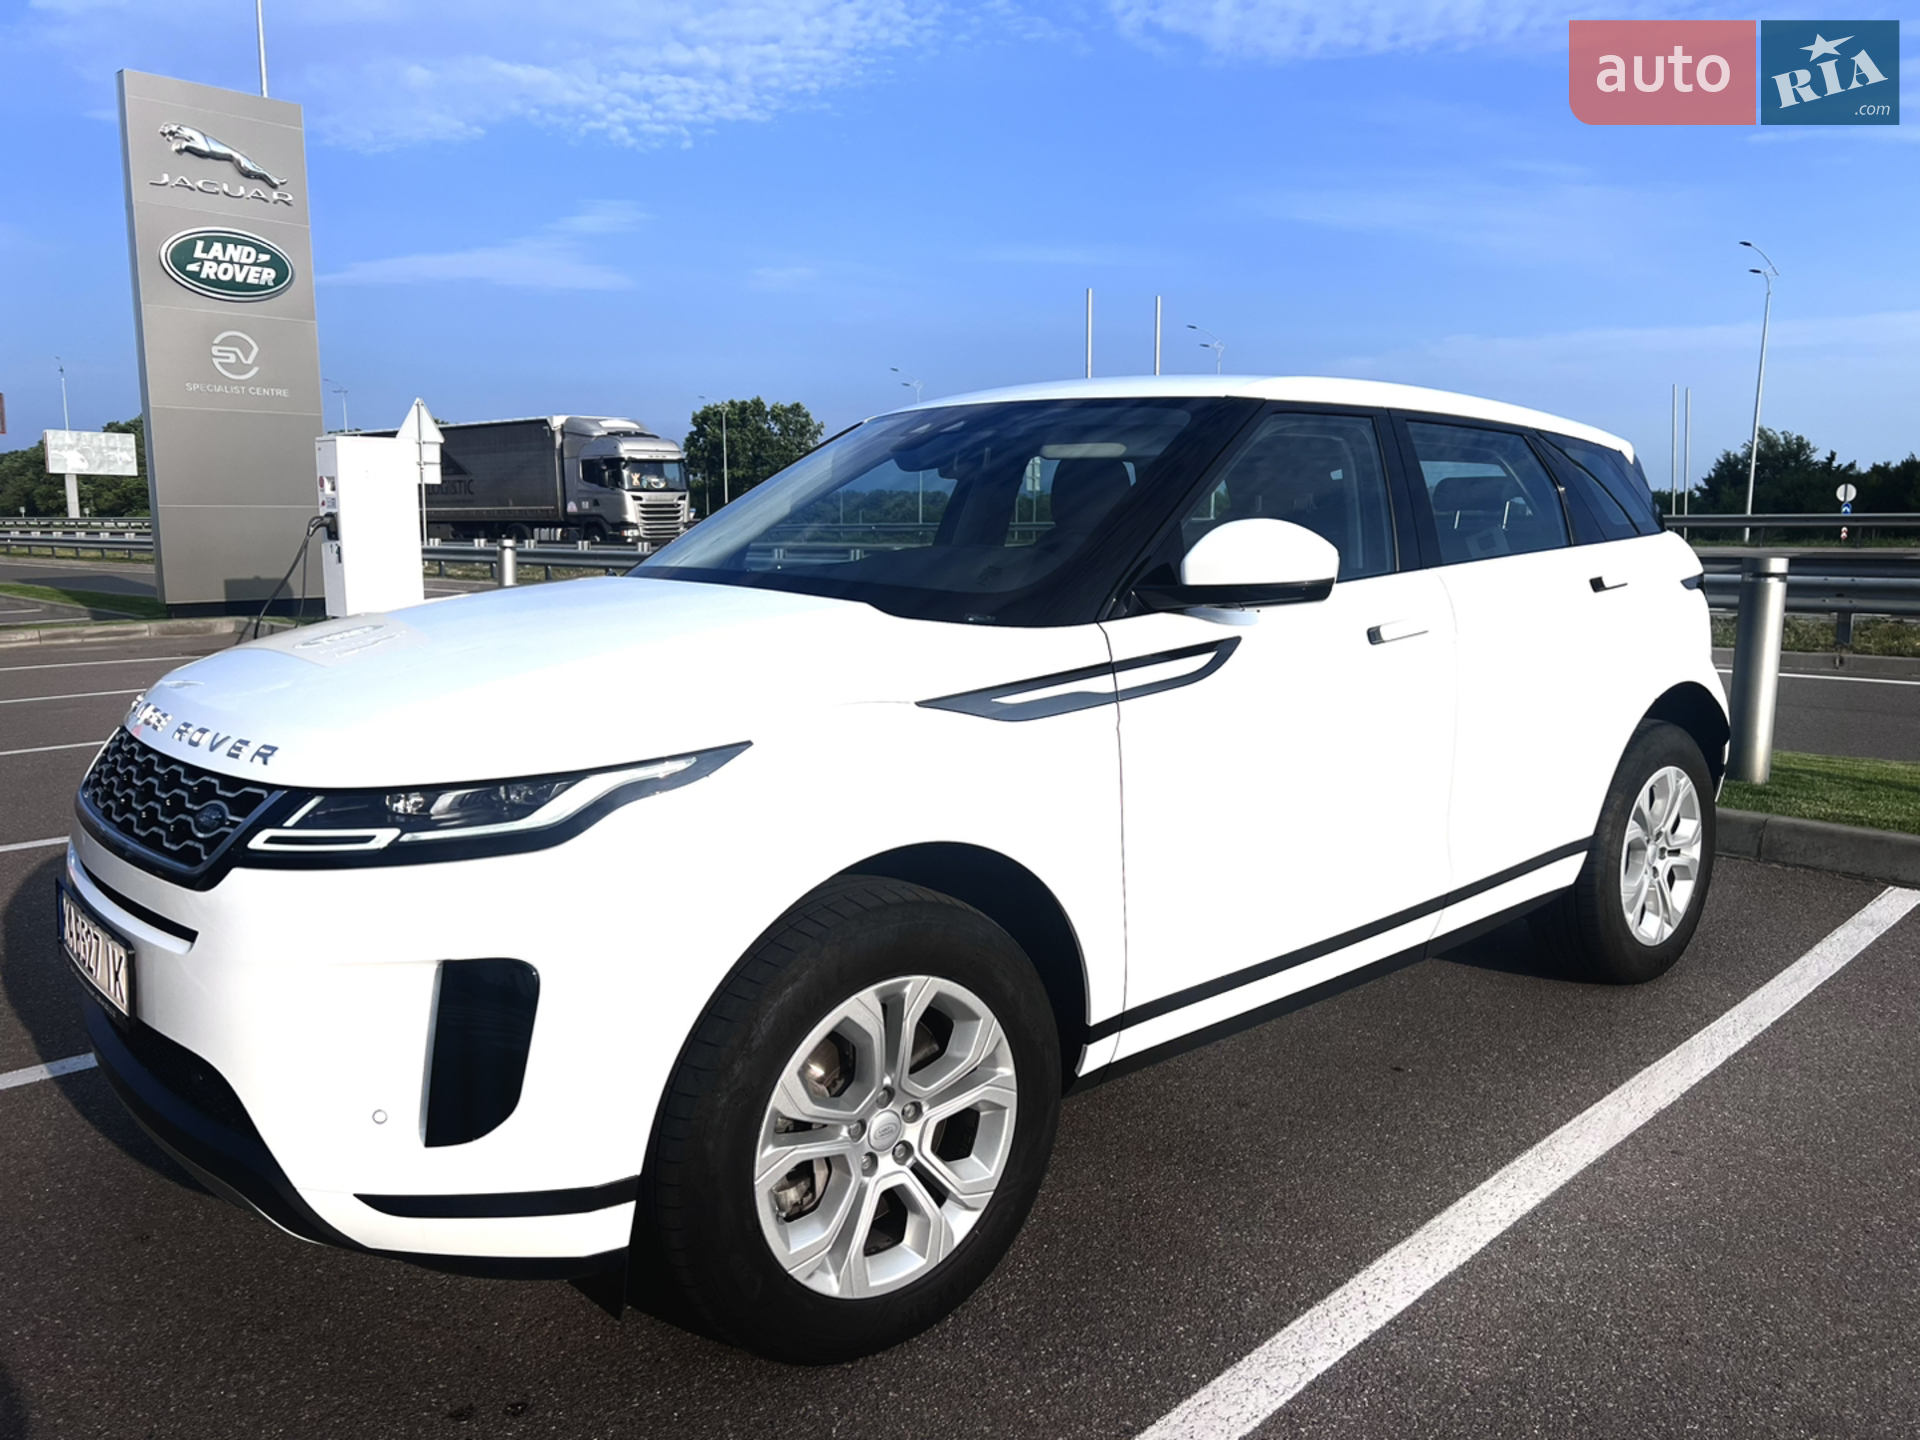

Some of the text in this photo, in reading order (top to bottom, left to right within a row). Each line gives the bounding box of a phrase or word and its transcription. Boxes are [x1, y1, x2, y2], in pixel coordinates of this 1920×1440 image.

[149, 172, 294, 206] JAGUAR
[193, 240, 256, 264] LAND
[200, 262, 276, 286] ROVER
[185, 382, 289, 397] SPECIALIST CENTRE
[172, 722, 278, 765] ROVER
